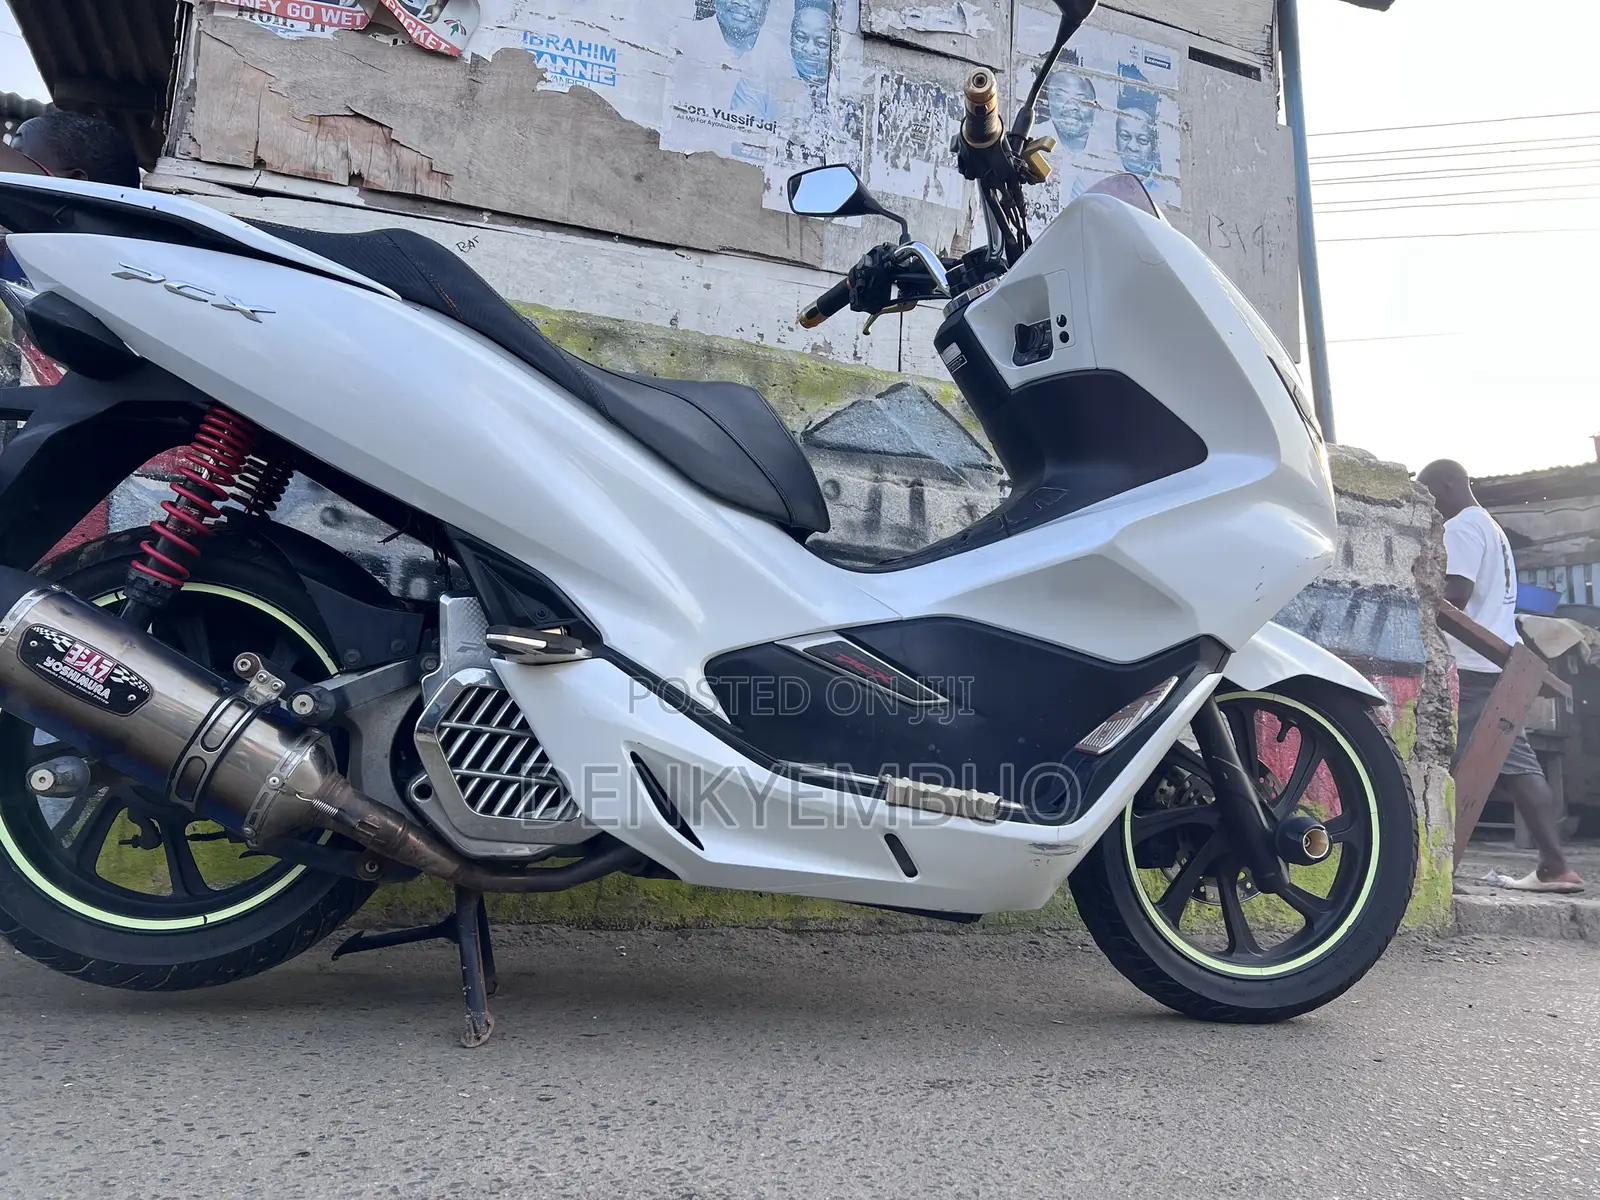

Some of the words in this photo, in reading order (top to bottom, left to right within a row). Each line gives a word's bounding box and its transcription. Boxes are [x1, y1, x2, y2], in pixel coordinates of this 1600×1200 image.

[287, 4, 314, 19] GO
[321, 7, 365, 26] WET
[523, 31, 616, 63] IBRAHIM
[712, 107, 755, 127] Yussif
[111, 262, 276, 324] PCX
[43, 656, 111, 699] YOSHIMURA
[835, 655, 892, 684] PCX
